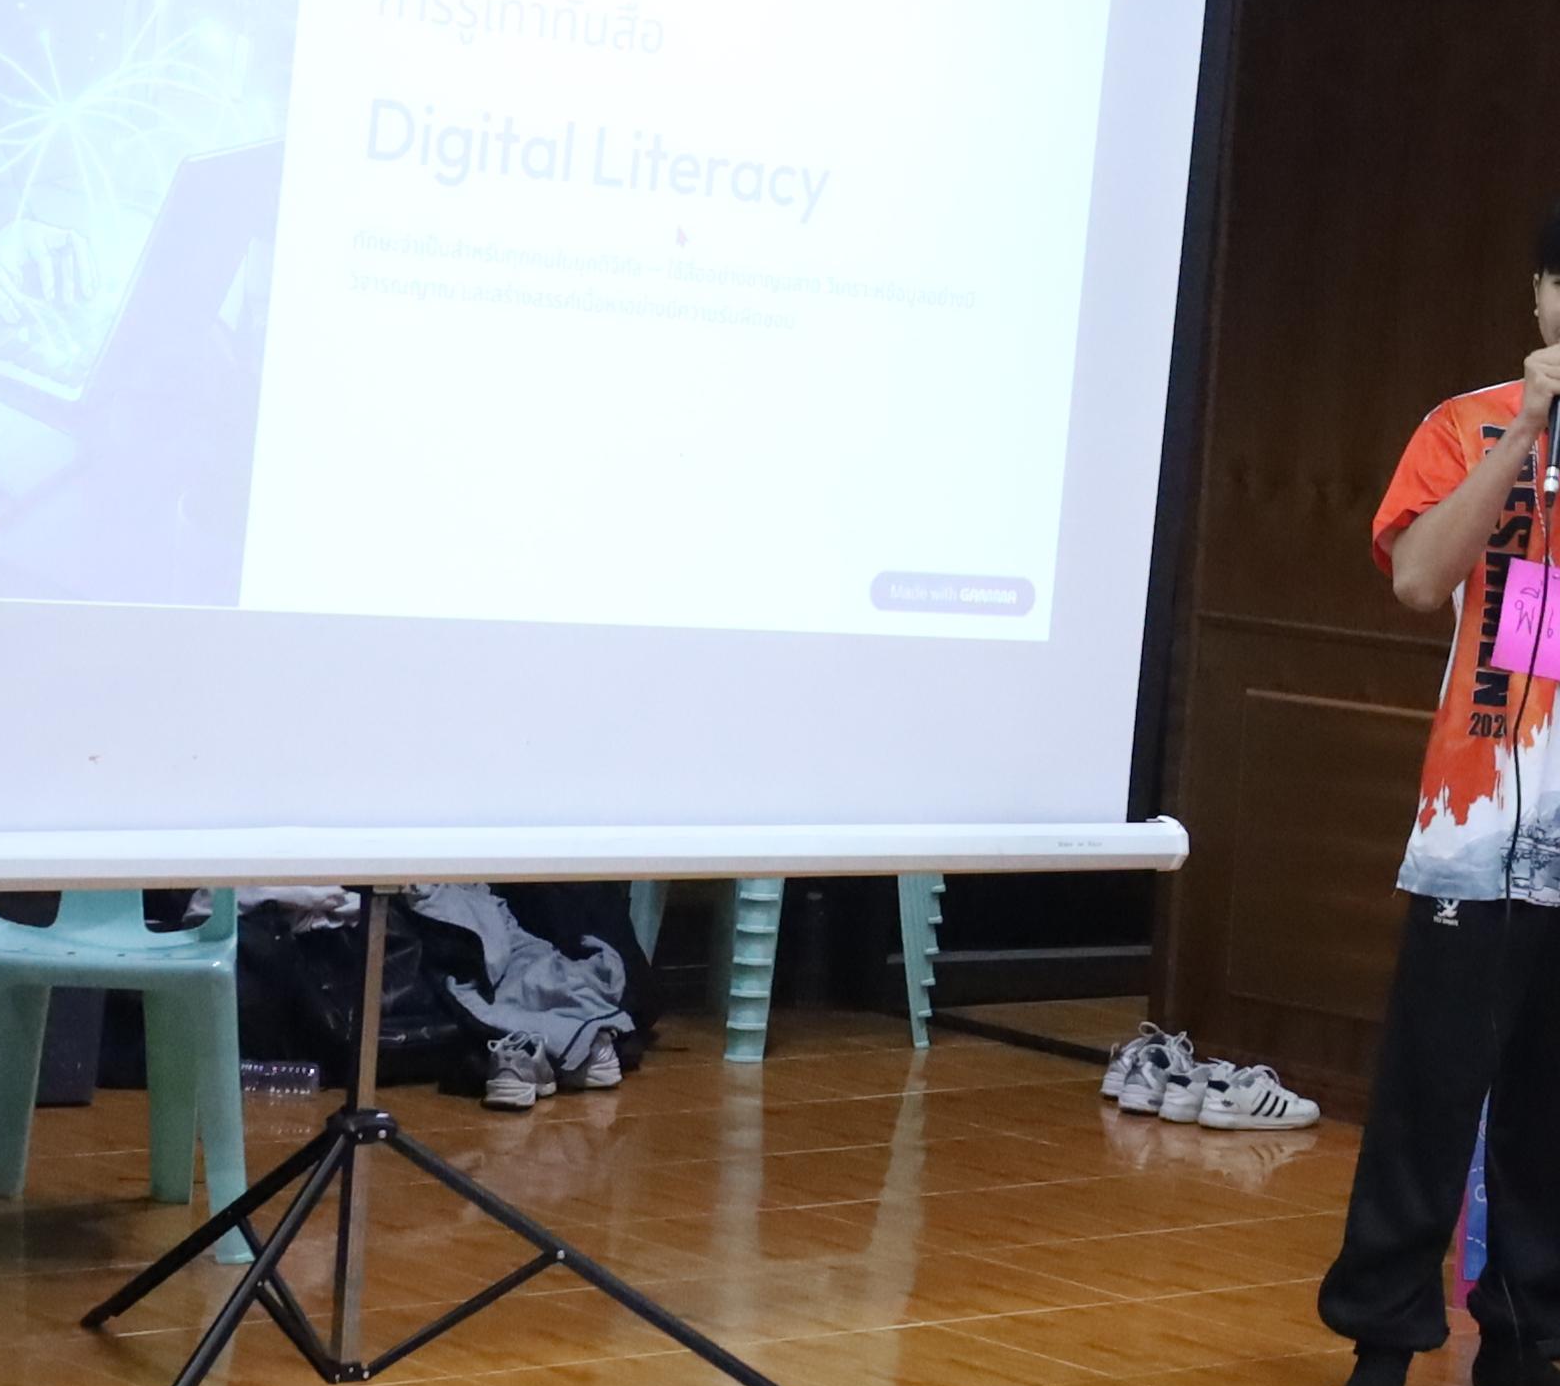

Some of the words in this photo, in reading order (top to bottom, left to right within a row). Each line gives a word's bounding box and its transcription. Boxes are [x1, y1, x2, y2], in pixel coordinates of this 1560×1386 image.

[364, 97, 576, 188] Digital
[591, 121, 832, 226] Literacy
[891, 584, 928, 601] Made
[930, 586, 958, 602] with
[1468, 710, 1508, 740] 202
